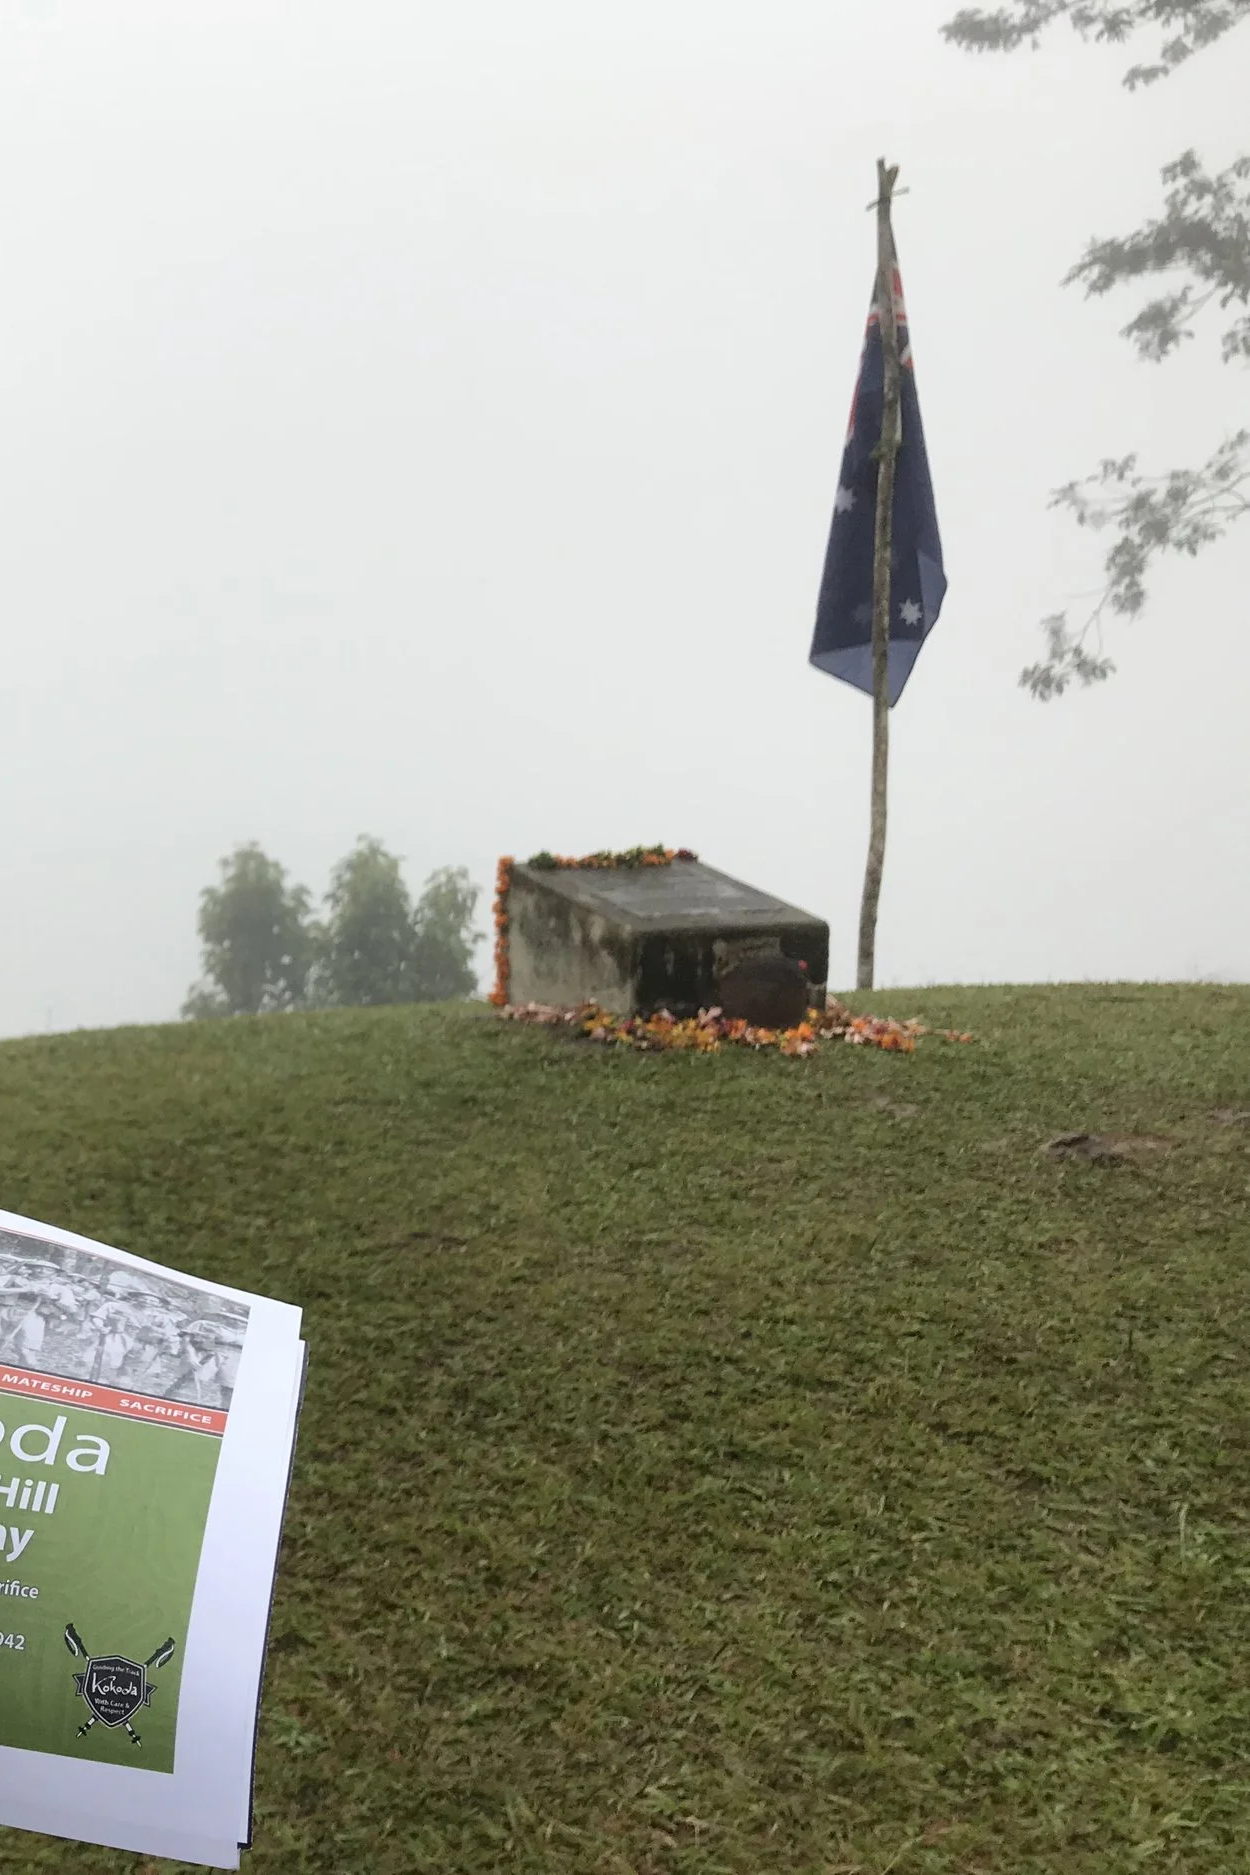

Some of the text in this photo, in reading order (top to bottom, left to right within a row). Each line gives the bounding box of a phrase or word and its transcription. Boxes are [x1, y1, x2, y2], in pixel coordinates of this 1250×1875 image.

[1, 1373, 93, 1398] MATESHIP
[119, 1399, 213, 1424] SACRIFICE
[92, 1672, 138, 1696] Kokoda
